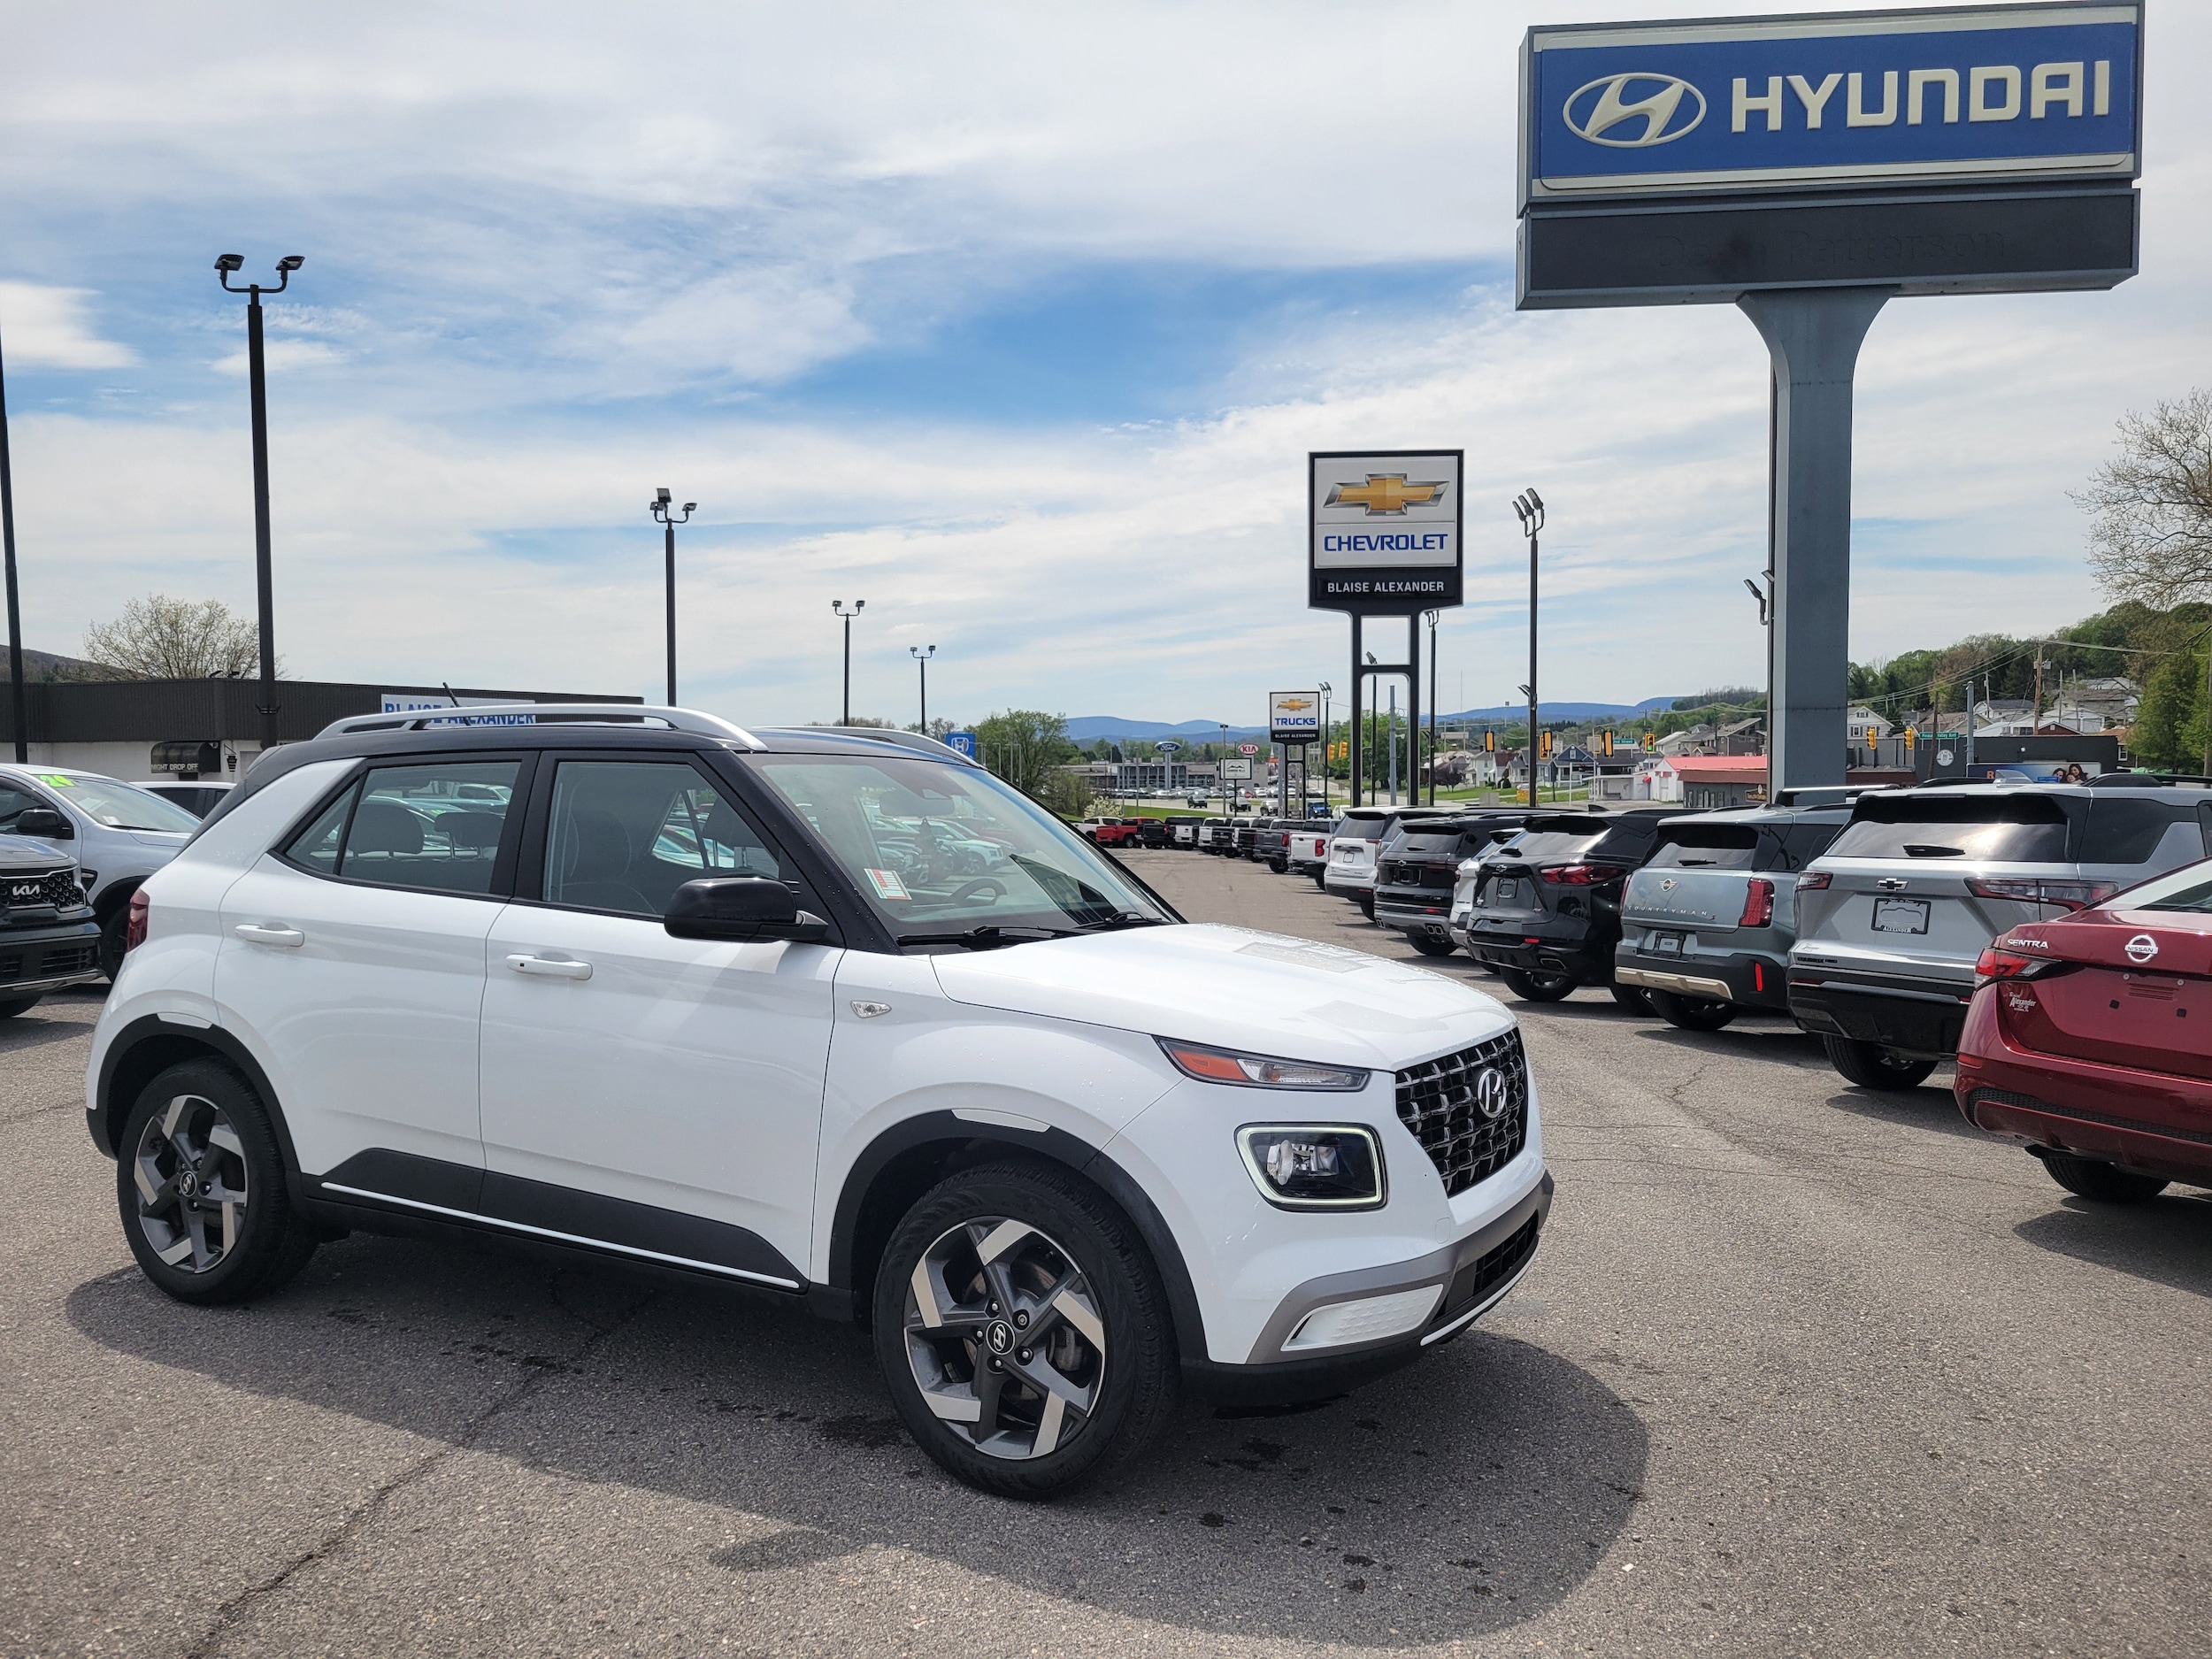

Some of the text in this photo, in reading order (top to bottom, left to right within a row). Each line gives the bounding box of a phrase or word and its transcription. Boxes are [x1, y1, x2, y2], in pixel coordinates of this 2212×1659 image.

[1732, 59, 2109, 134] HYUNDAI
[1324, 534, 1448, 552] CHEVROLET
[1327, 580, 1444, 593] BLAISE ALEXANDER
[2007, 939, 2049, 949] SENTRA
